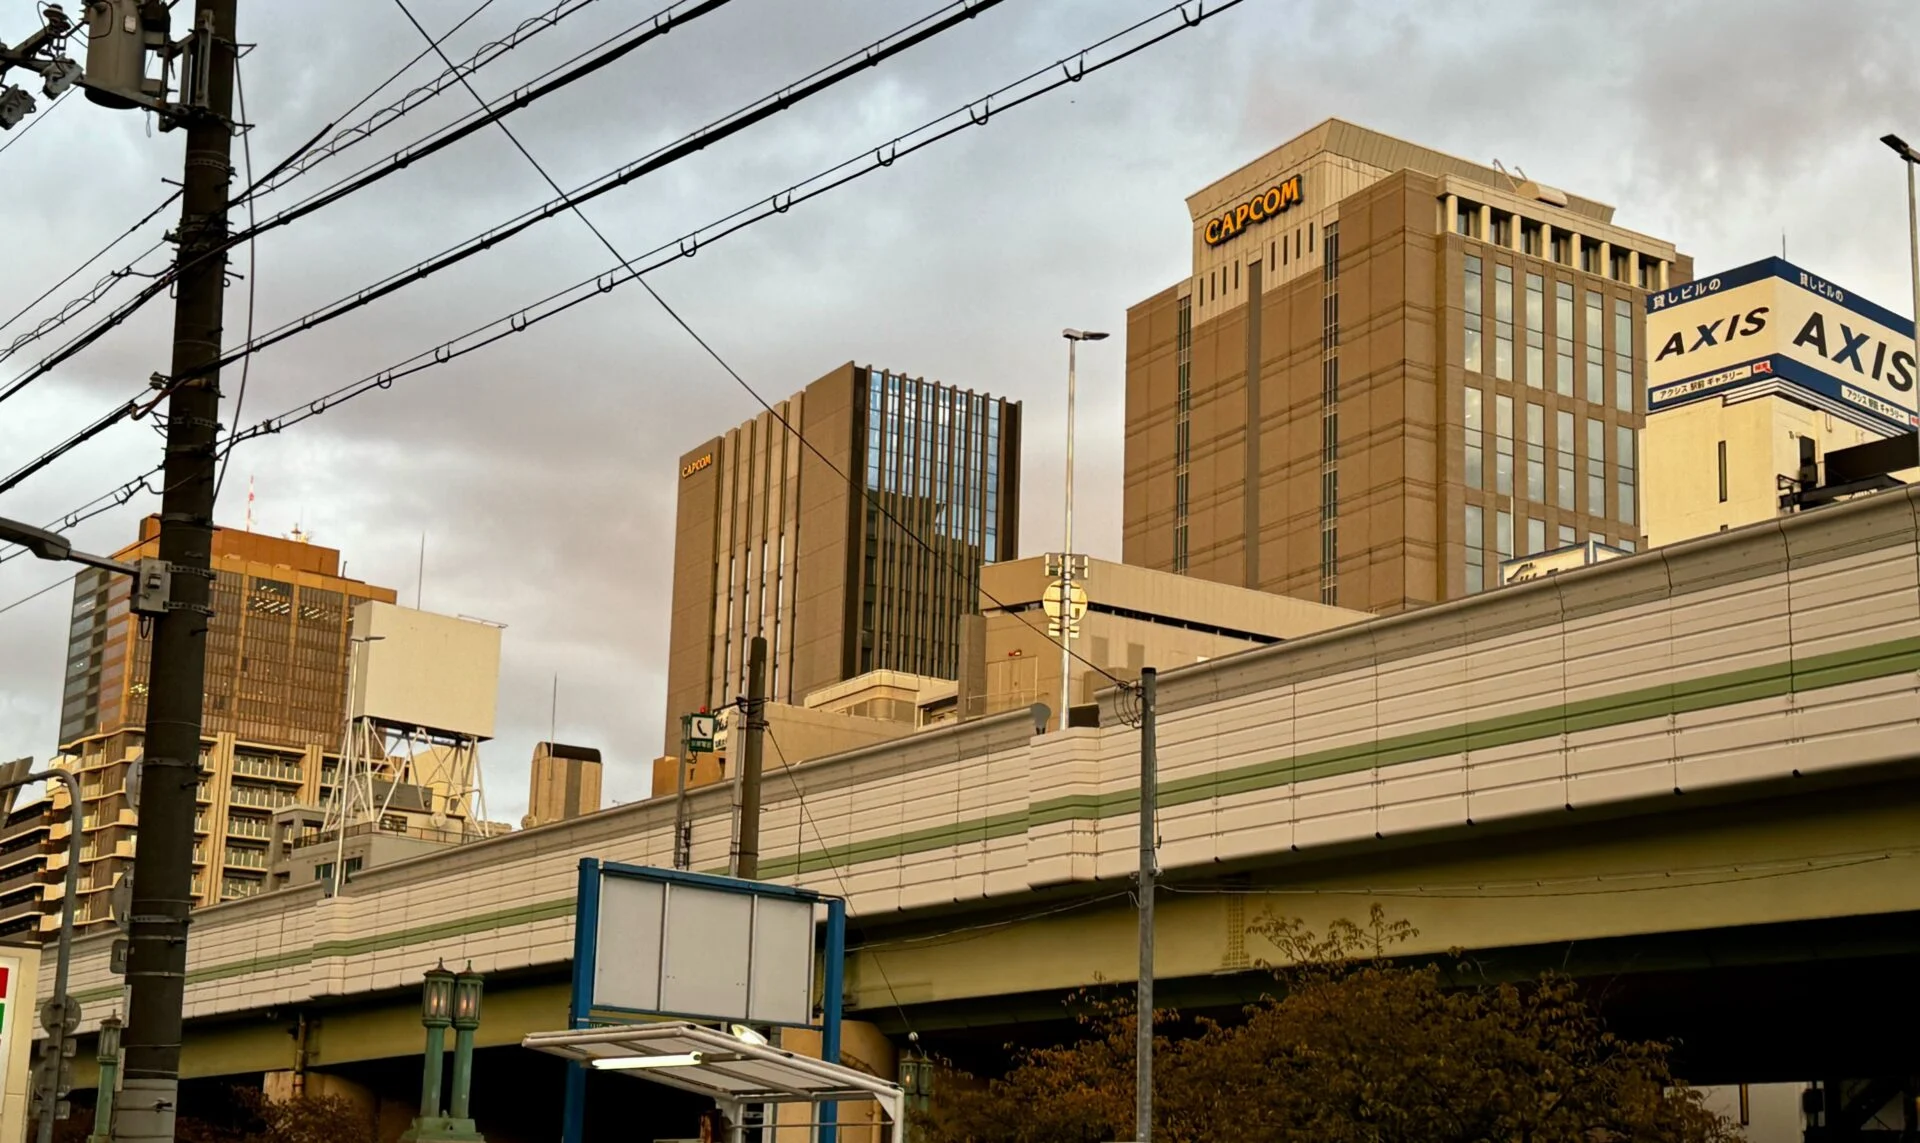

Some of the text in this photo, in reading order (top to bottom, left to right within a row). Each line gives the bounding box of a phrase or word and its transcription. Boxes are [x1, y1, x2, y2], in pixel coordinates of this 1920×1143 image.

[1204, 174, 1303, 247] CAPCOM
[1653, 278, 1721, 310] 貸しビルの
[1800, 271, 1844, 302] 貸しビルの
[1655, 306, 1770, 362] AXIS
[1792, 311, 1917, 392] AXIS
[682, 453, 712, 479] CAPCOM
